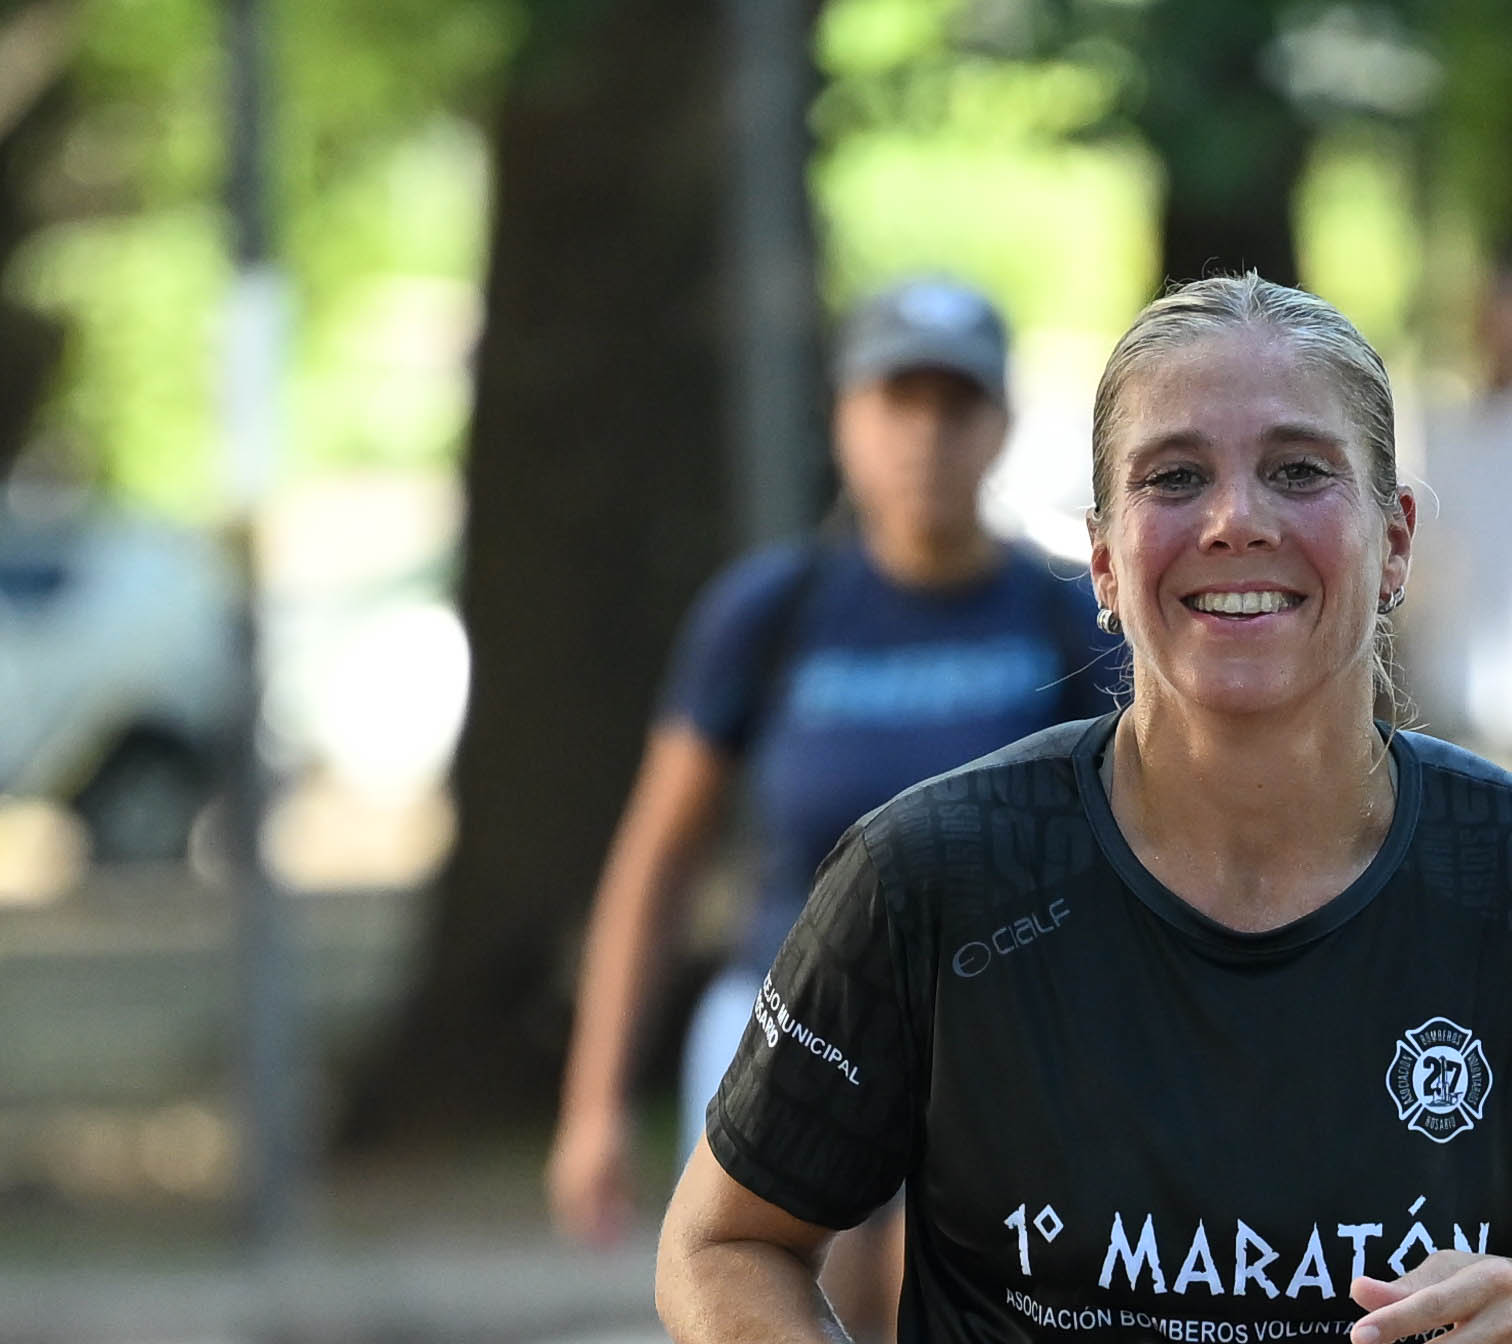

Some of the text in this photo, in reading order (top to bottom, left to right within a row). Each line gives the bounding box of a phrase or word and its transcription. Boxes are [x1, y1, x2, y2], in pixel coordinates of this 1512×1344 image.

[1423, 1055, 1462, 1096] 27
[1006, 1288, 1112, 1331] ASOCIACIÓN
[1120, 1310, 1248, 1344] BOMBEROS
